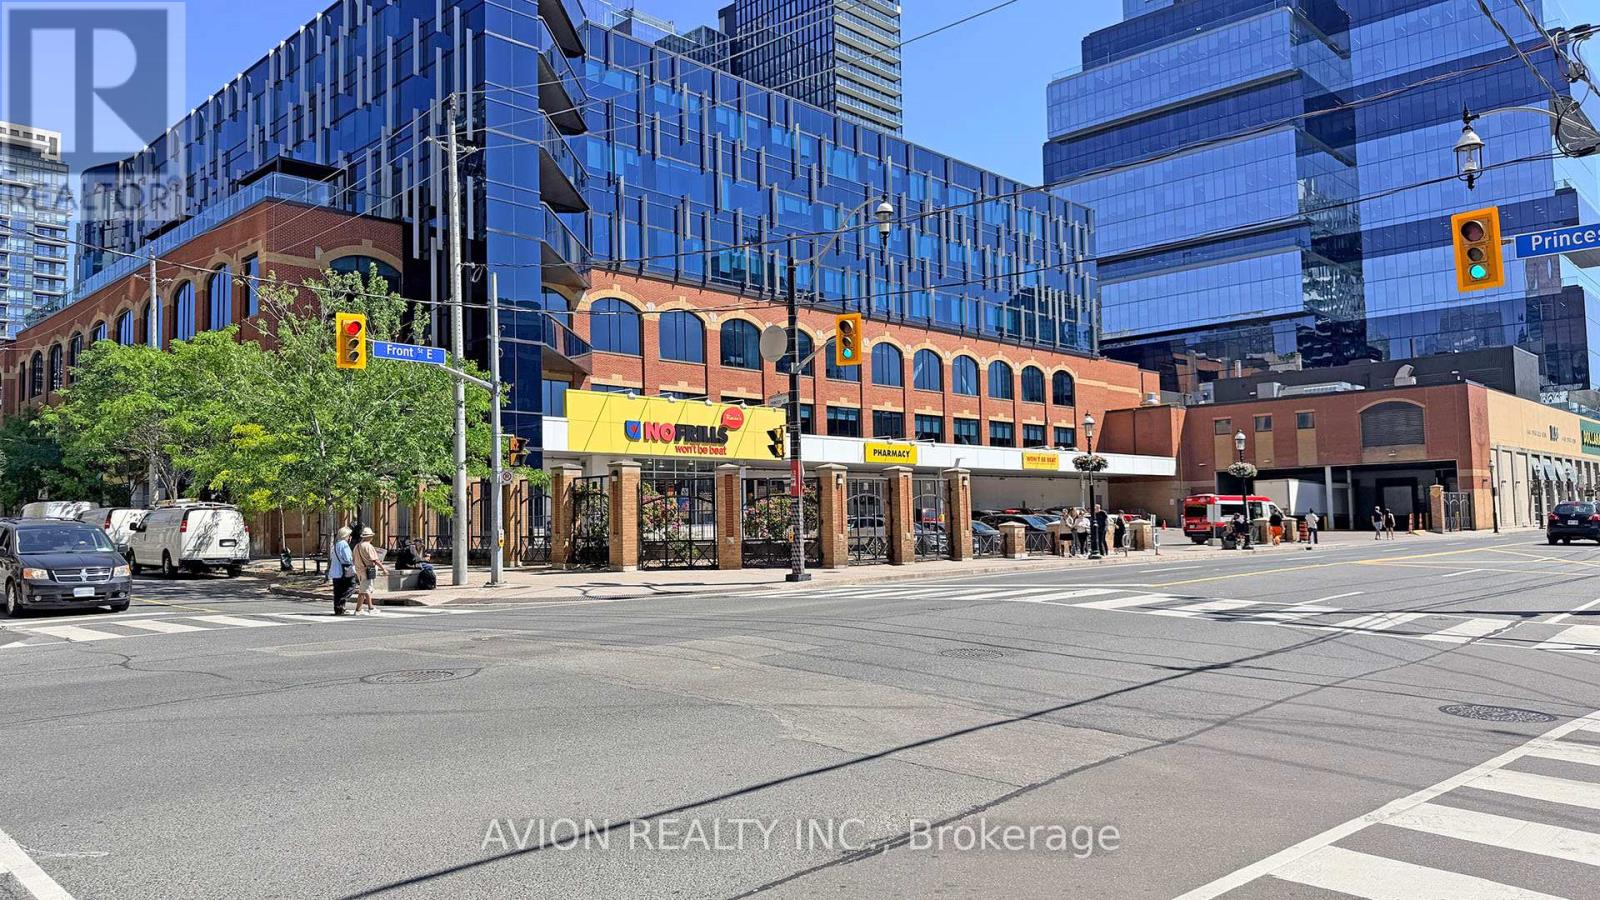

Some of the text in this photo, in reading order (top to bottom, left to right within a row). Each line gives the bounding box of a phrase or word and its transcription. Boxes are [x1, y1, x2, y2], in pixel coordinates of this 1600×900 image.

[386, 344, 414, 357] Front
[426, 348, 433, 360] E
[674, 445, 727, 455] won't be beat
[873, 448, 911, 458] PHARMACY
